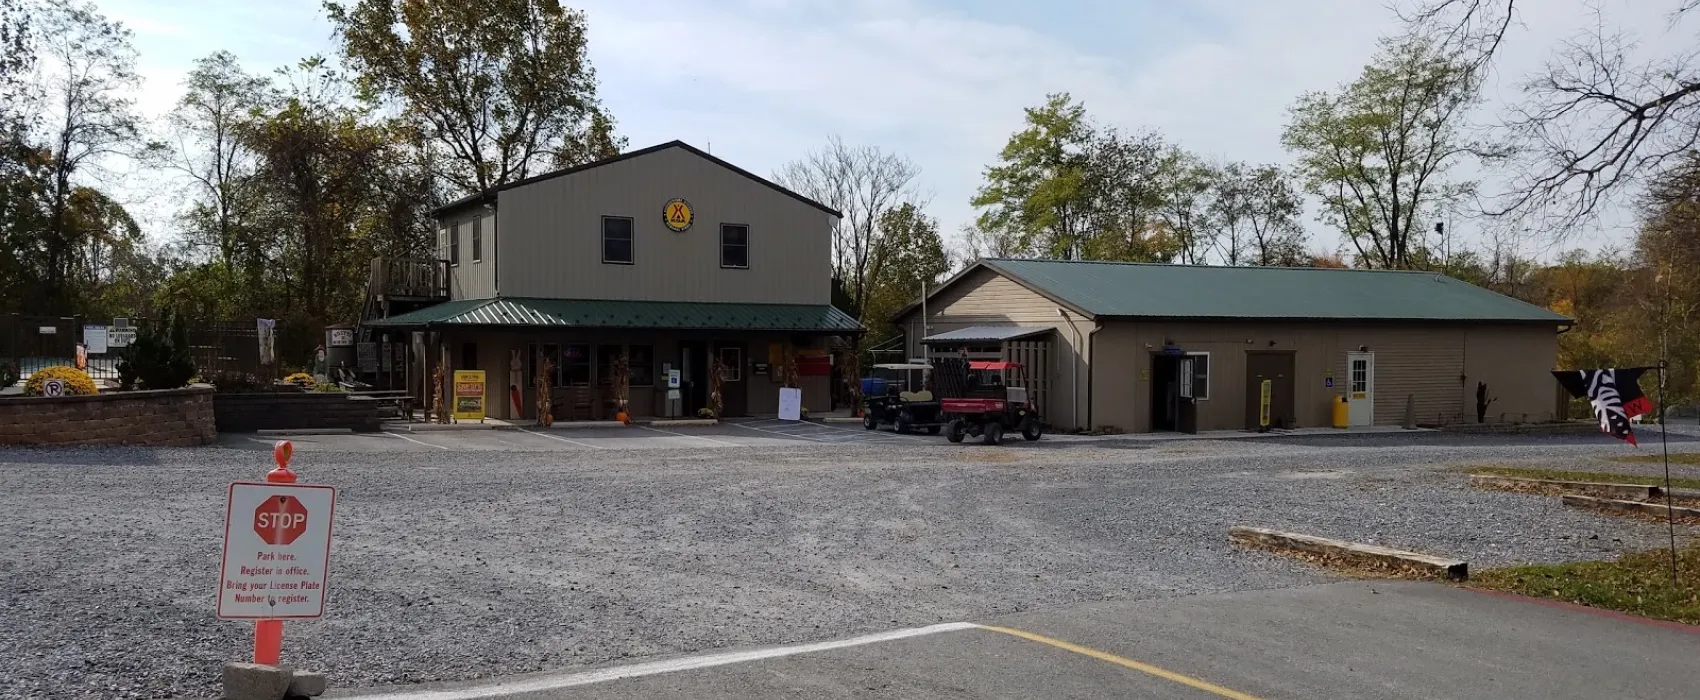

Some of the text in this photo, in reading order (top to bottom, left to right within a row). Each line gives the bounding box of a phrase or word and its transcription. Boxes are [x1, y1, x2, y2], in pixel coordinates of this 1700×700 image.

[257, 512, 305, 529] STOP
[257, 552, 297, 561] Park here.
[240, 566, 310, 576] Register in office.
[226, 581, 320, 591] Bring your License Plate
[234, 594, 309, 605] Number to register.
